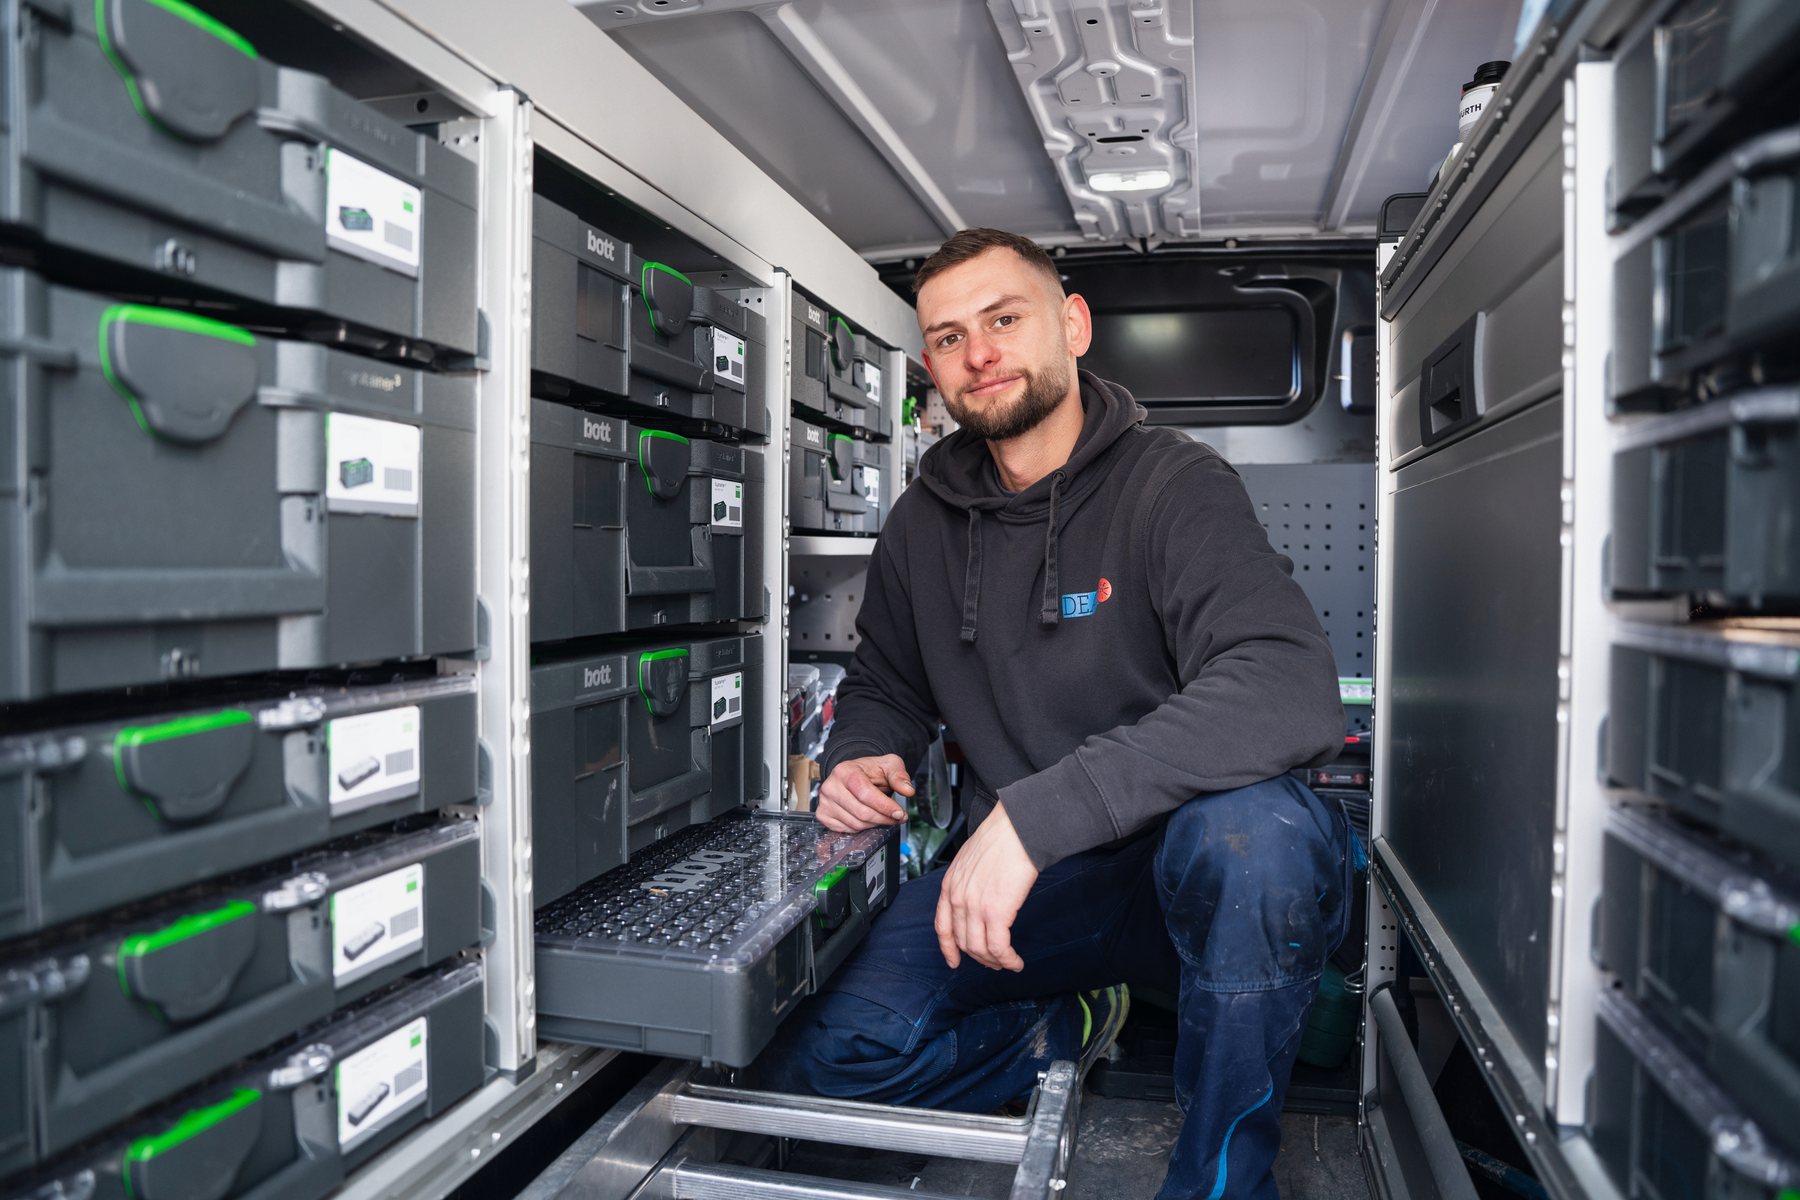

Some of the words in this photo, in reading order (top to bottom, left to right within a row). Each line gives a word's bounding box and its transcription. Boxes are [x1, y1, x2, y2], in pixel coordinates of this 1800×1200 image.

[1459, 103, 1482, 118] ÜRTH
[587, 229, 615, 262] bott
[807, 305, 821, 325] bott
[583, 417, 612, 443] bott
[806, 426, 820, 444] bott
[584, 664, 612, 688] bott
[640, 849, 752, 893] bott
